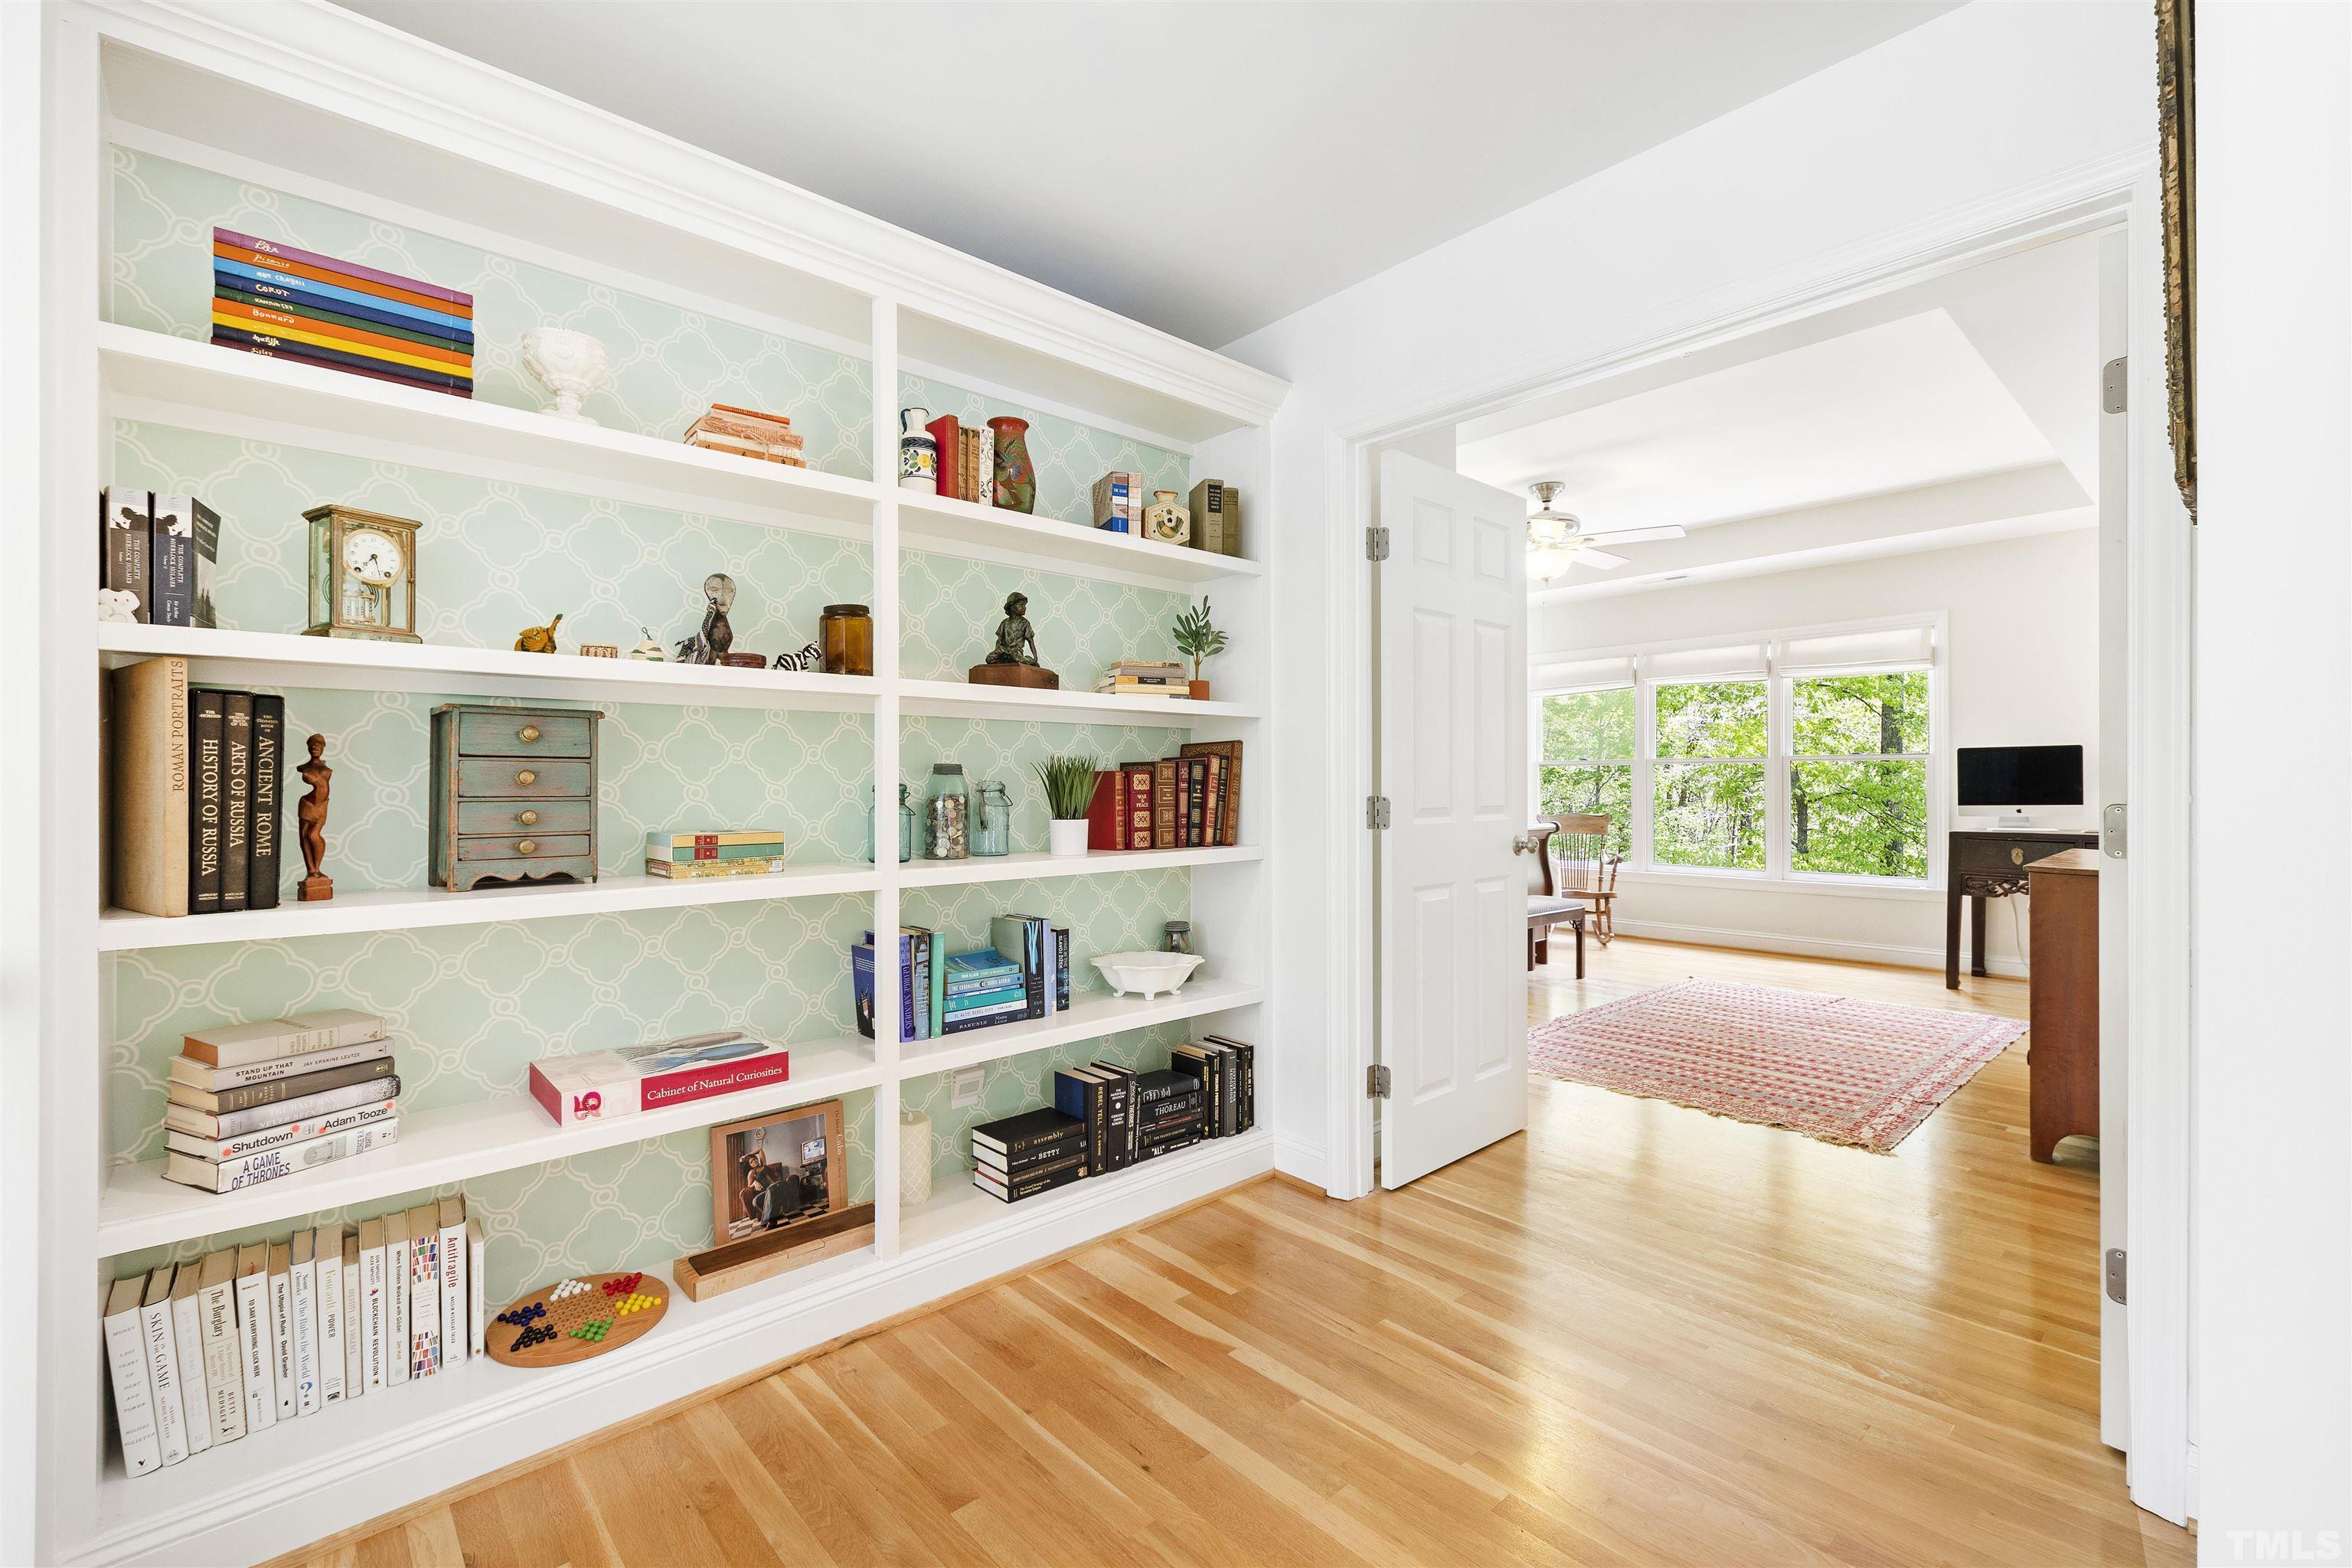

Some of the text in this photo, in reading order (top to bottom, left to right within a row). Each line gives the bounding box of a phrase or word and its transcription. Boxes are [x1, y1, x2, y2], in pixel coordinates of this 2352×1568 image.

[255, 283, 290, 296] COROT
[253, 309, 295, 324] Bonnard
[171, 660, 184, 792] ROMAN PORTRAITS
[229, 741, 247, 848] ARTS OF RUSSIA
[256, 736, 274, 858] ANCIENT ROME
[201, 738, 219, 877] HISTORY OF RUSSIA
[903, 966, 911, 994] GEORGE
[959, 1020, 988, 1029] BAKUNIN
[235, 1061, 294, 1078] STAND UP THAT
[315, 1057, 338, 1065] ERSKINE
[245, 1070, 285, 1082] MOUNTAIN
[647, 1066, 783, 1101] Cabinet of Natural Curiosities
[268, 1096, 337, 1116] THE HALF HAS
[1155, 1101, 1186, 1116] THOREAU
[258, 1116, 292, 1129] NEVER
[324, 1108, 388, 1129] Adam Tooze
[232, 1131, 293, 1154] Shutdown
[1034, 1132, 1063, 1145] assembly
[243, 1152, 280, 1173] A GAME
[1038, 1148, 1060, 1160] BETTY
[231, 1163, 290, 1191] OF THRONES
[446, 1237, 459, 1288] Antifragile
[211, 1289, 227, 1338] The Burglary
[278, 1294, 286, 1313] Utopia
[299, 1297, 308, 1317] Who
[325, 1269, 338, 1338] Foucault POWER
[112, 1325, 136, 1337] MONEY
[149, 1312, 165, 1343] SKIN
[279, 1318, 287, 1336] Rules
[299, 1317, 308, 1340] Rules
[118, 1358, 139, 1369] YEARS
[155, 1353, 171, 1391] GAME
[302, 1354, 311, 1379] World
[126, 1393, 141, 1401] AND
[217, 1390, 227, 1424] MEDSGER
[227, 1391, 237, 1416] BETTY
[123, 1402, 145, 1413] POWER
[159, 1396, 168, 1423] NICHOLAS
[125, 1423, 151, 1435] MICHEL
[124, 1432, 155, 1447] AGLIETTA
